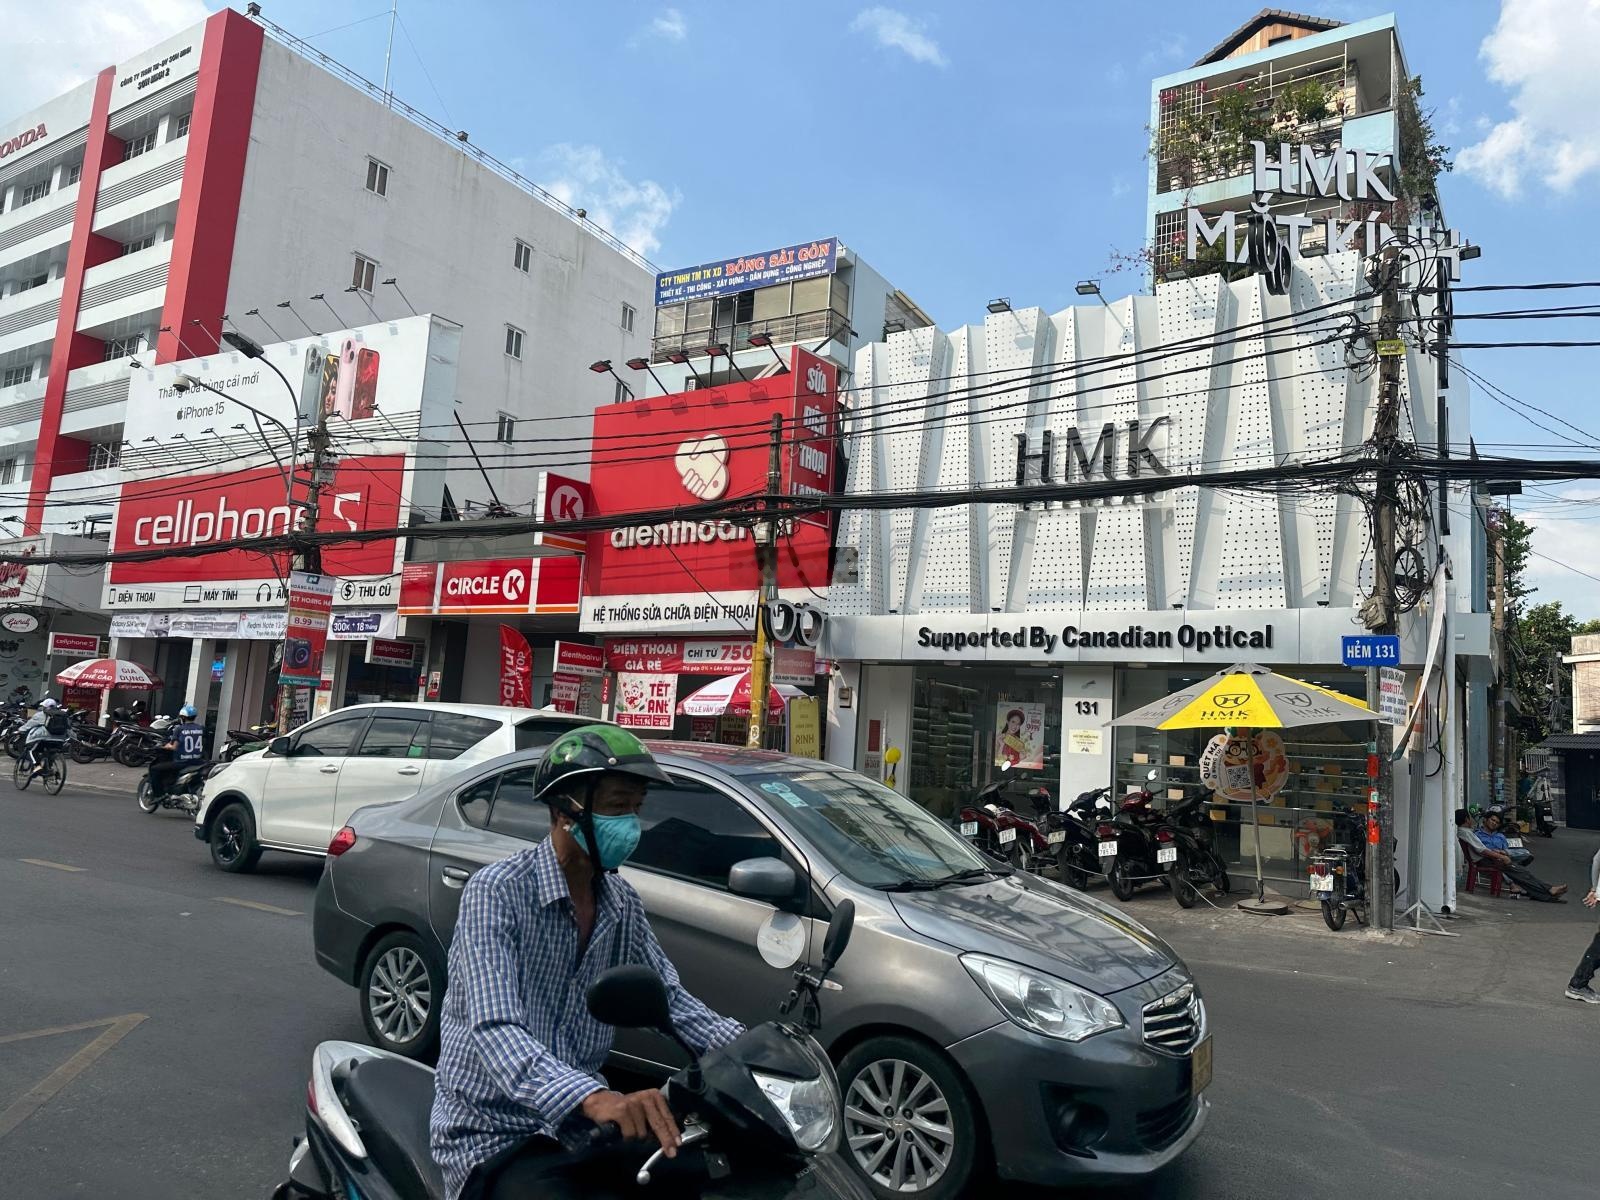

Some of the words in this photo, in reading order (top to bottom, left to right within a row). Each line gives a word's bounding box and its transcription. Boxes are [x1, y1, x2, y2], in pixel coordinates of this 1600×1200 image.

[0, 123, 48, 158] ONDA
[1250, 140, 1397, 202] HMK
[660, 276, 672, 288] CTY
[673, 273, 690, 285] TNHH
[692, 270, 702, 282] TM
[703, 268, 712, 279] TK
[712, 266, 722, 276] XD
[687, 284, 696, 294] THI
[696, 280, 712, 292] CÔNG
[716, 278, 728, 288] XÂY
[785, 264, 802, 274] CÔNG
[226, 374, 241, 388] cái
[241, 371, 260, 386] mới
[806, 363, 827, 397] SỬA
[184, 405, 214, 420] iPhone
[214, 401, 225, 416] 15
[1014, 416, 1171, 486] HMK
[800, 444, 828, 479] THOẠI
[118, 590, 134, 604] ĐIỆN
[136, 592, 156, 604] THOẠI
[204, 588, 218, 600] MÁY
[222, 588, 238, 600] TÍNH
[359, 586, 376, 598] THU
[378, 582, 392, 597] CŨ
[446, 576, 500, 596] CIRCLE
[294, 616, 312, 626] 8.99
[593, 604, 606, 624] HỆ
[608, 602, 640, 621] THỐNG
[642, 603, 662, 622] SỬA
[664, 603, 690, 620] CHỮA
[694, 602, 718, 622] ĐIỆN
[722, 604, 754, 621] THOẠI
[356, 622, 364, 632] 18
[918, 626, 1028, 651] Supported
[1030, 626, 1058, 653] By
[1062, 625, 1173, 648] Canadian
[1178, 624, 1272, 652] Optical
[614, 643, 638, 656] ĐIỆN
[642, 644, 678, 656] THOẠI
[688, 648, 702, 658] CHỈ
[706, 648, 718, 658] TỪ
[1346, 640, 1372, 658] HẺM
[1376, 644, 1396, 658] 131
[624, 658, 644, 670] GIÁ
[650, 681, 671, 697] TẾT
[1074, 701, 1098, 716] 131
[1292, 706, 1336, 716] HMK
[184, 736, 203, 752] 04
[1210, 742, 1220, 755] MÃ
